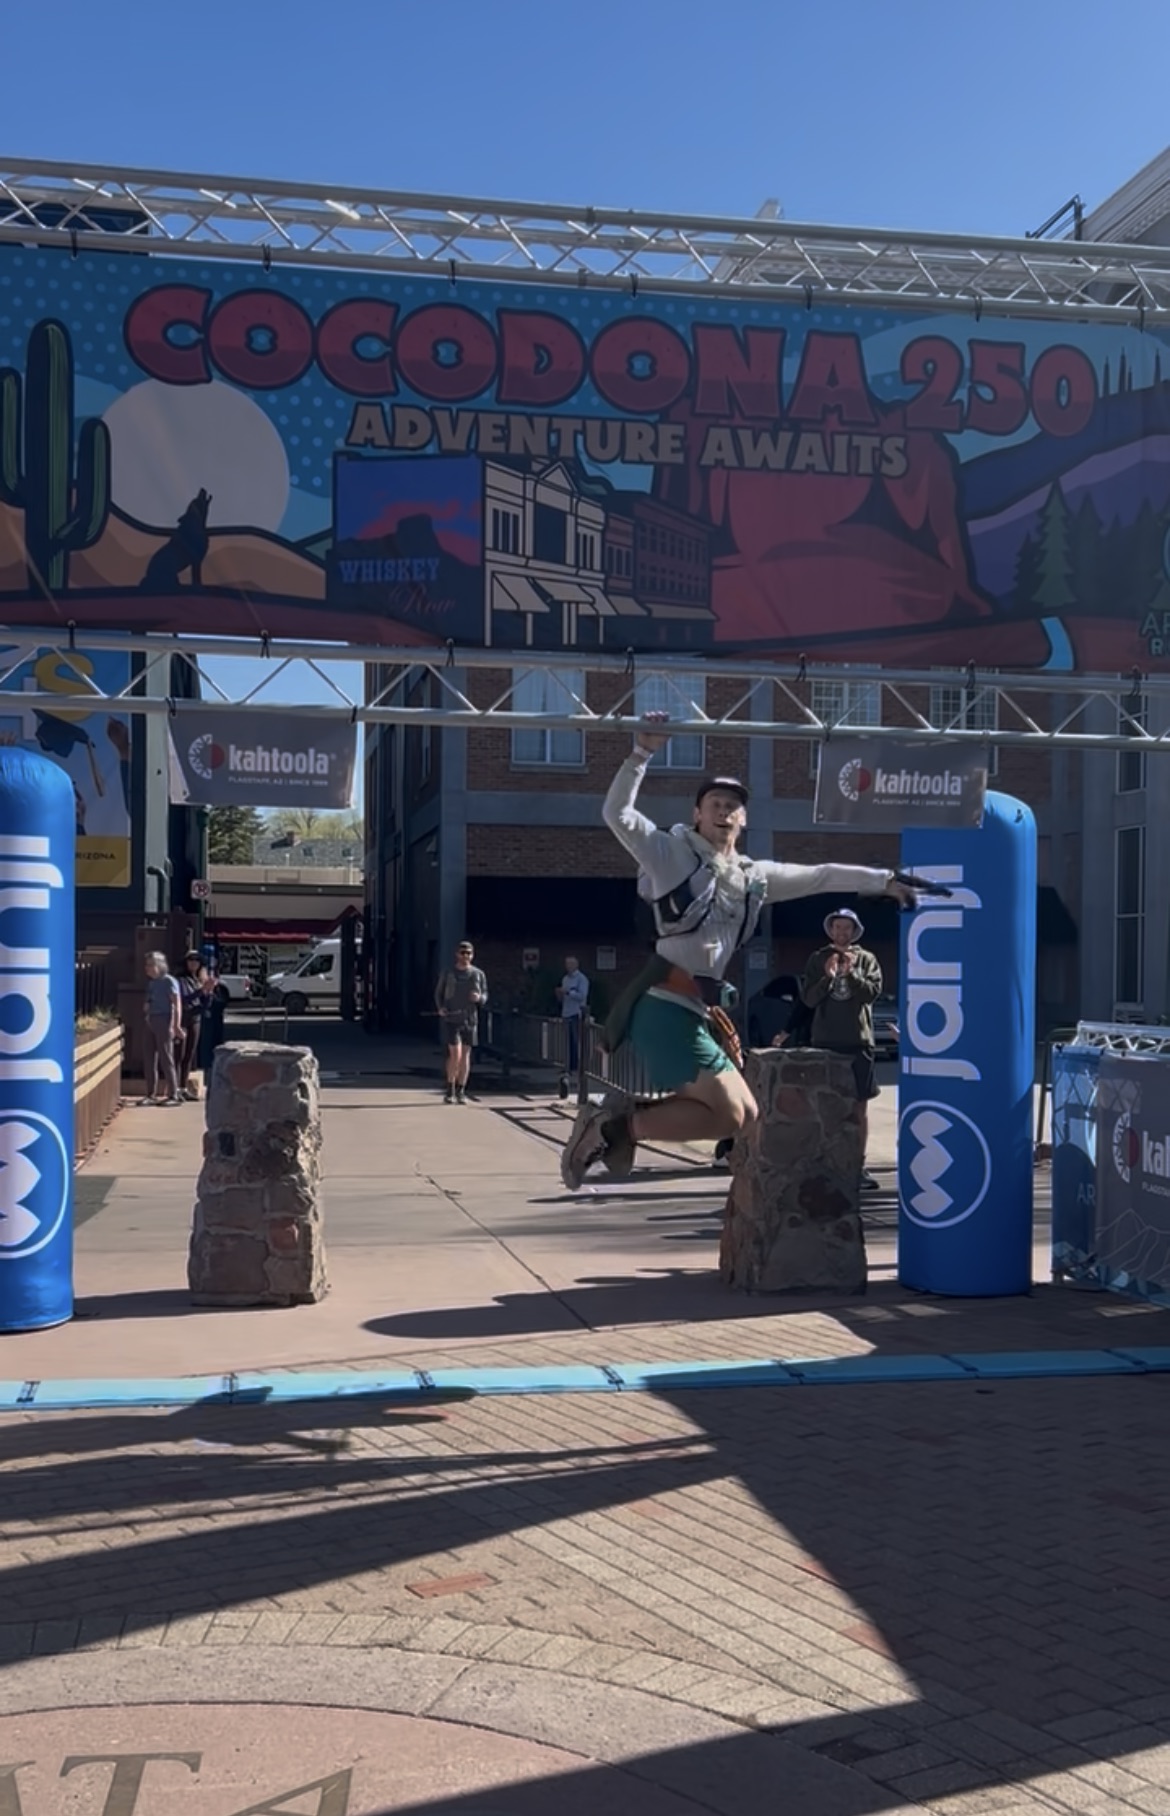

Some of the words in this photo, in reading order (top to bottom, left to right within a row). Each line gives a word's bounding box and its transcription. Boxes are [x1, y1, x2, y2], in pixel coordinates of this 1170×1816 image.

[124, 283, 878, 426] COCODONA
[899, 335, 1099, 437] 250
[347, 402, 685, 464] ADVENTURE
[700, 423, 908, 478] AWAITS
[338, 557, 440, 584] WHISKEY
[229, 744, 329, 775] kahtoola
[874, 767, 962, 796] kahtoola
[75, 851, 116, 861] RIZONA
[902, 864, 982, 1081] janji
